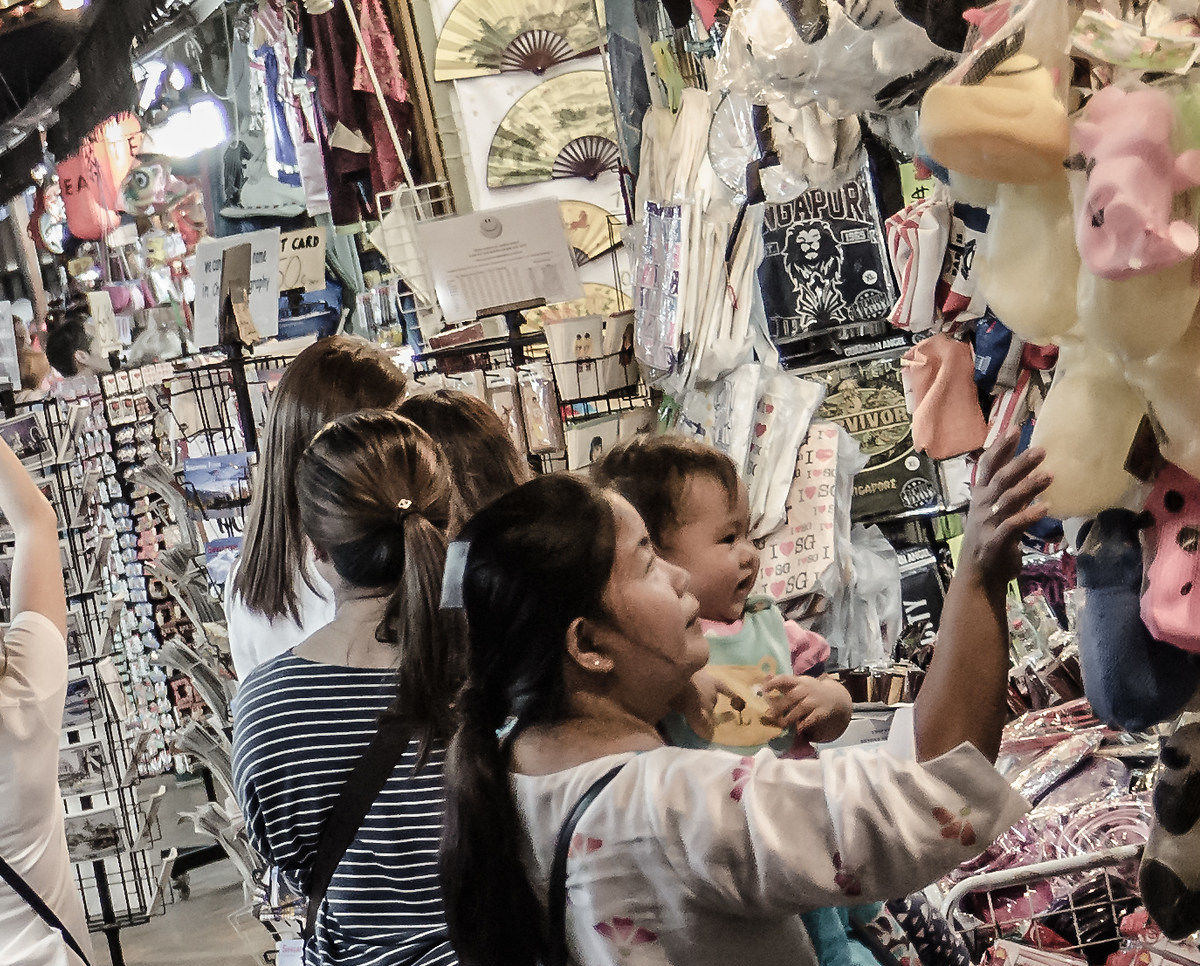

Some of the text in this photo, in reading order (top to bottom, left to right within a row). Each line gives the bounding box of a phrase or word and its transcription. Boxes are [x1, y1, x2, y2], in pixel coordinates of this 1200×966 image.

[291, 235, 320, 251] CARD
[795, 534, 816, 554] SG
[785, 572, 808, 594] SG
